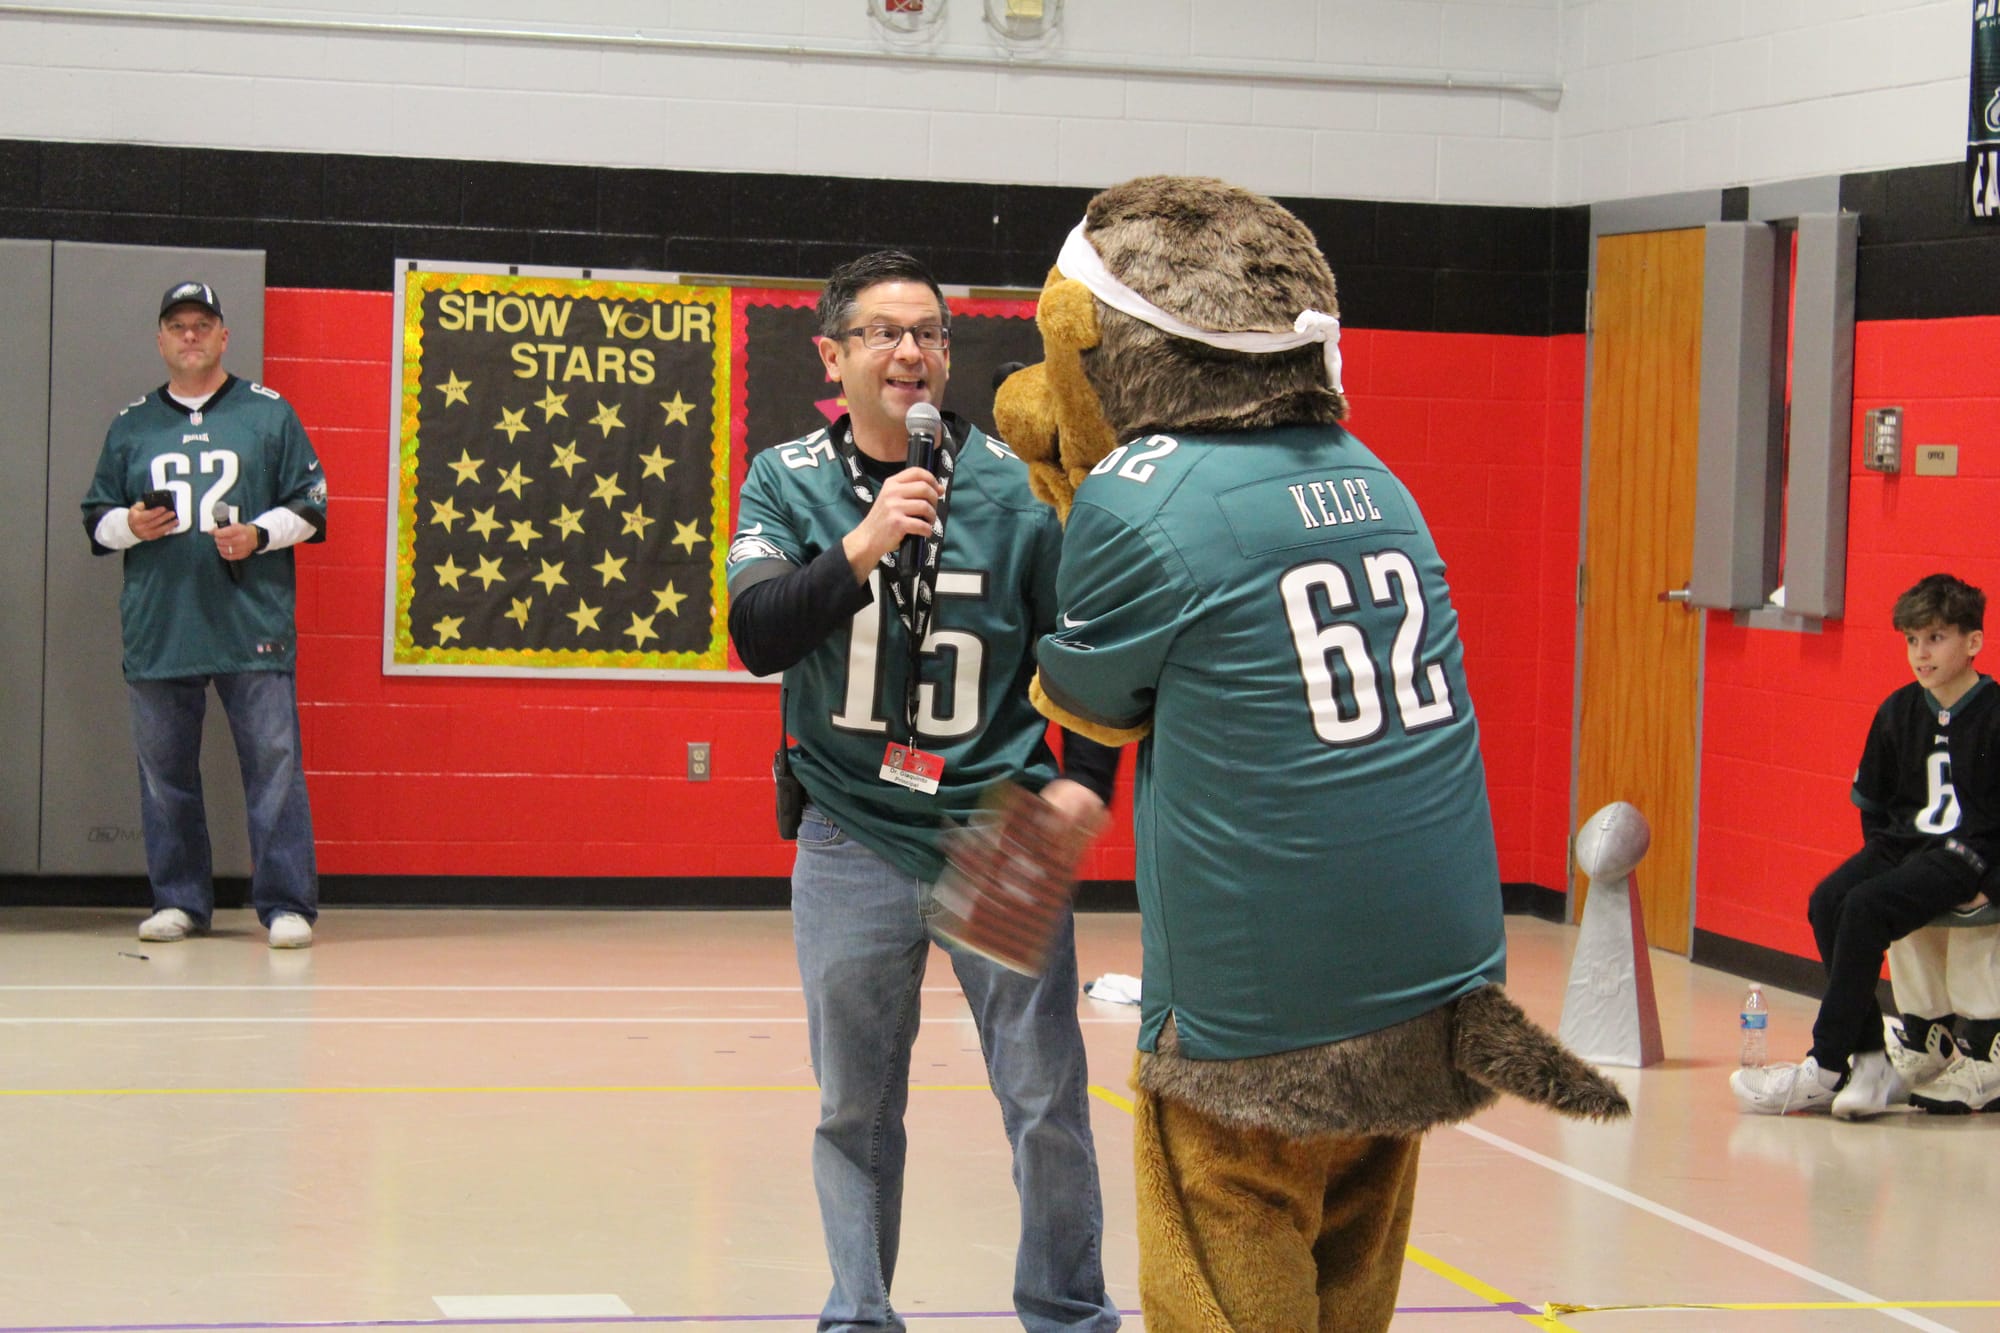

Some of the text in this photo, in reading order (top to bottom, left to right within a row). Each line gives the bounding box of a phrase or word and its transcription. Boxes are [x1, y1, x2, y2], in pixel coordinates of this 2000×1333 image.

[438, 294, 711, 343] SHOW YOUR
[510, 343, 656, 385] STARS
[150, 449, 240, 535] 62
[1287, 476, 1383, 530] KELCE
[830, 569, 986, 739] 15
[1279, 549, 1457, 746] 62
[1915, 752, 1961, 834] 6
